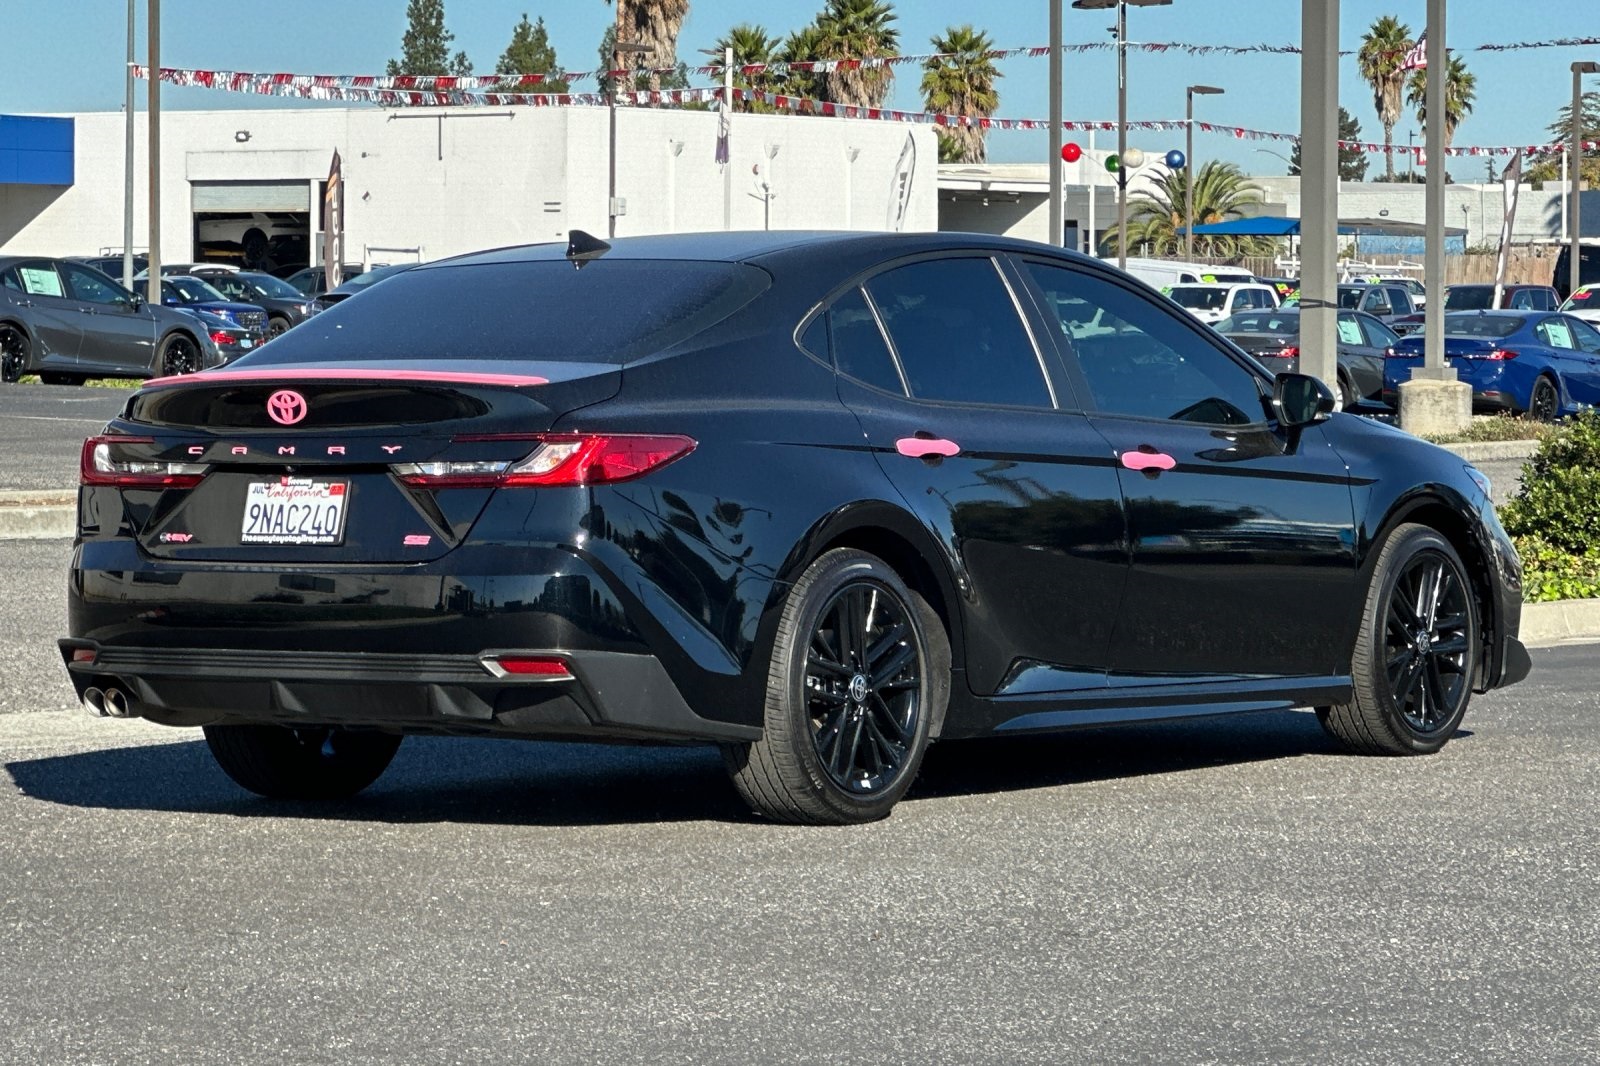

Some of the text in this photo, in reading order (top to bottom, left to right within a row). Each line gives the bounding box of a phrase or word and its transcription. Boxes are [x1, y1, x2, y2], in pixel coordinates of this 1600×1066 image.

[188, 445, 402, 455] CAMRY
[252, 486, 265, 494] JUL
[267, 485, 329, 502] California
[247, 503, 338, 535] 9NAC240
